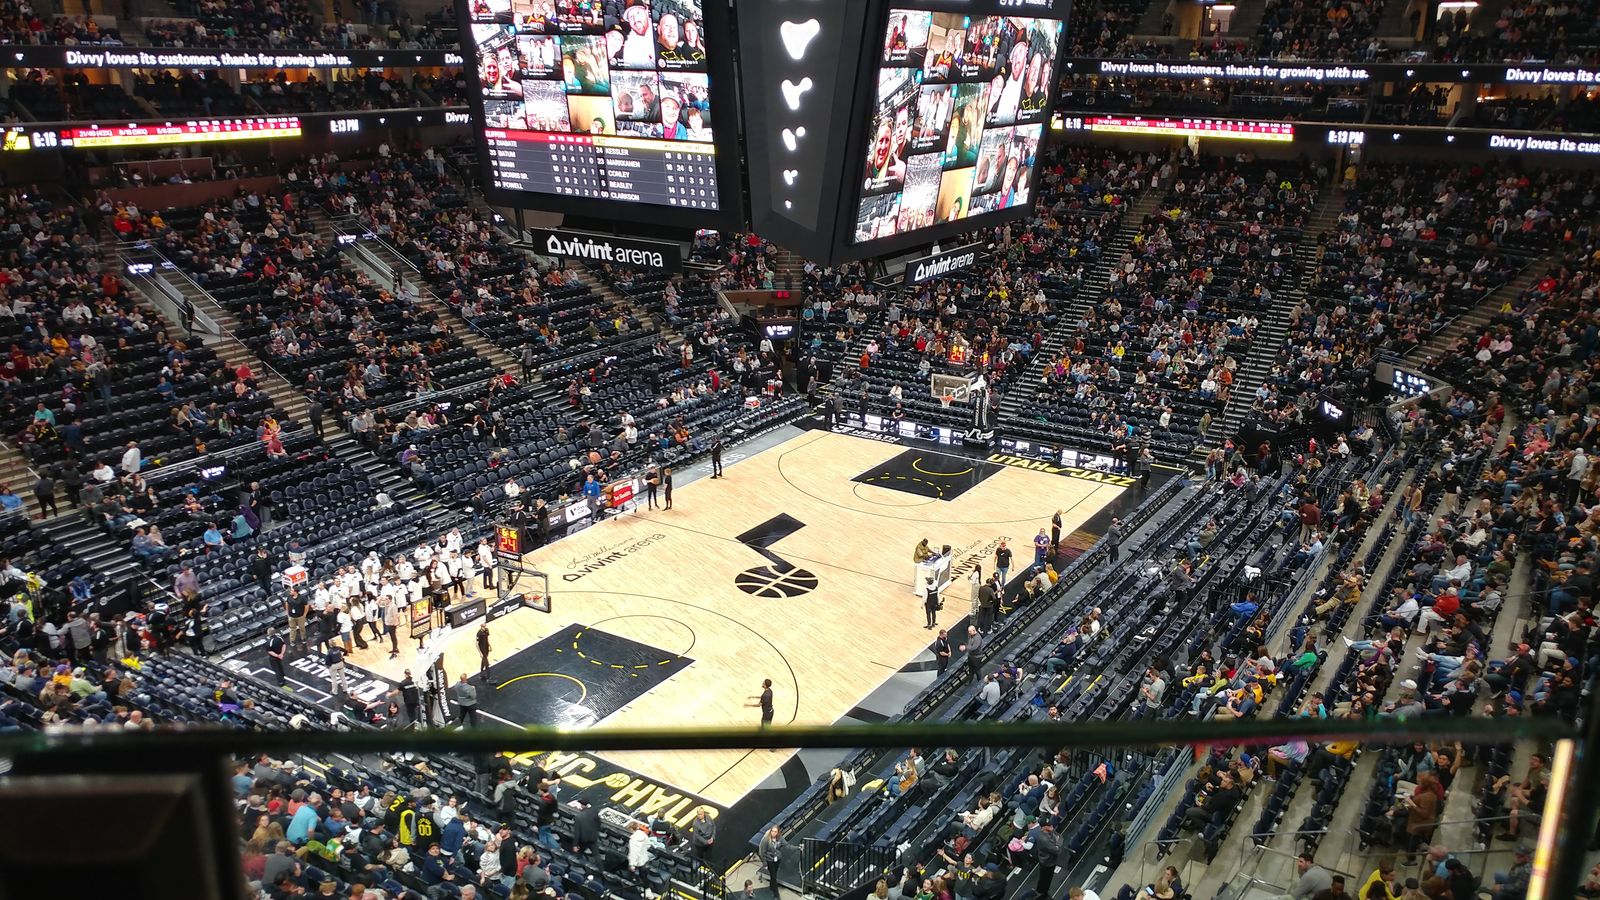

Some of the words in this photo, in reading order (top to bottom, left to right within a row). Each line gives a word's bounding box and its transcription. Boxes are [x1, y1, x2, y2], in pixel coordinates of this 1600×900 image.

[66, 51, 104, 67] Divvy
[105, 51, 139, 64] loves
[140, 52, 157, 64] its
[158, 54, 220, 66] customers,
[221, 53, 258, 65] thanks
[258, 53, 274, 65] for
[275, 54, 315, 67] growing
[316, 53, 336, 65] with
[338, 56, 352, 65] us.
[1101, 62, 1128, 73] Divvy
[1129, 62, 1155, 72] loves
[1156, 63, 1169, 73] its
[1170, 65, 1224, 76] customers,
[1226, 65, 1261, 76] thanks
[1263, 66, 1278, 76] for
[1280, 67, 1324, 79] growing
[1325, 67, 1350, 78] with
[1352, 70, 1369, 78] us.
[1506, 69, 1541, 83] Divvy
[1543, 69, 1576, 81] loves
[1577, 70, 1593, 81] its
[445, 112, 470, 123] Divvy
[347, 119, 359, 132] PM
[1328, 131, 1347, 143] 8:13
[1349, 131, 1364, 144] PM
[1490, 136, 1525, 150] Divvy
[1527, 137, 1558, 149] loves
[1560, 139, 1577, 151] its
[606, 159, 640, 168] MARKKANEN
[608, 170, 630, 178] CONLEY
[502, 182, 523, 190] POWELL
[609, 181, 633, 189] BEASLEY
[600, 190, 609, 198] 00
[610, 192, 640, 201] CLARKSON
[615, 247, 664, 268] arena
[950, 252, 975, 271] arena
[852, 430, 900, 444] HEALTH
[986, 453, 1050, 471] UTAH
[1069, 467, 1136, 487] JAZZ
[501, 538, 516, 552] 24
[624, 534, 666, 553] arena
[437, 669, 446, 688] FIRST
[439, 688, 451, 717] AMERICA
[390, 800, 399, 812] 2
[418, 824, 432, 837] 00
